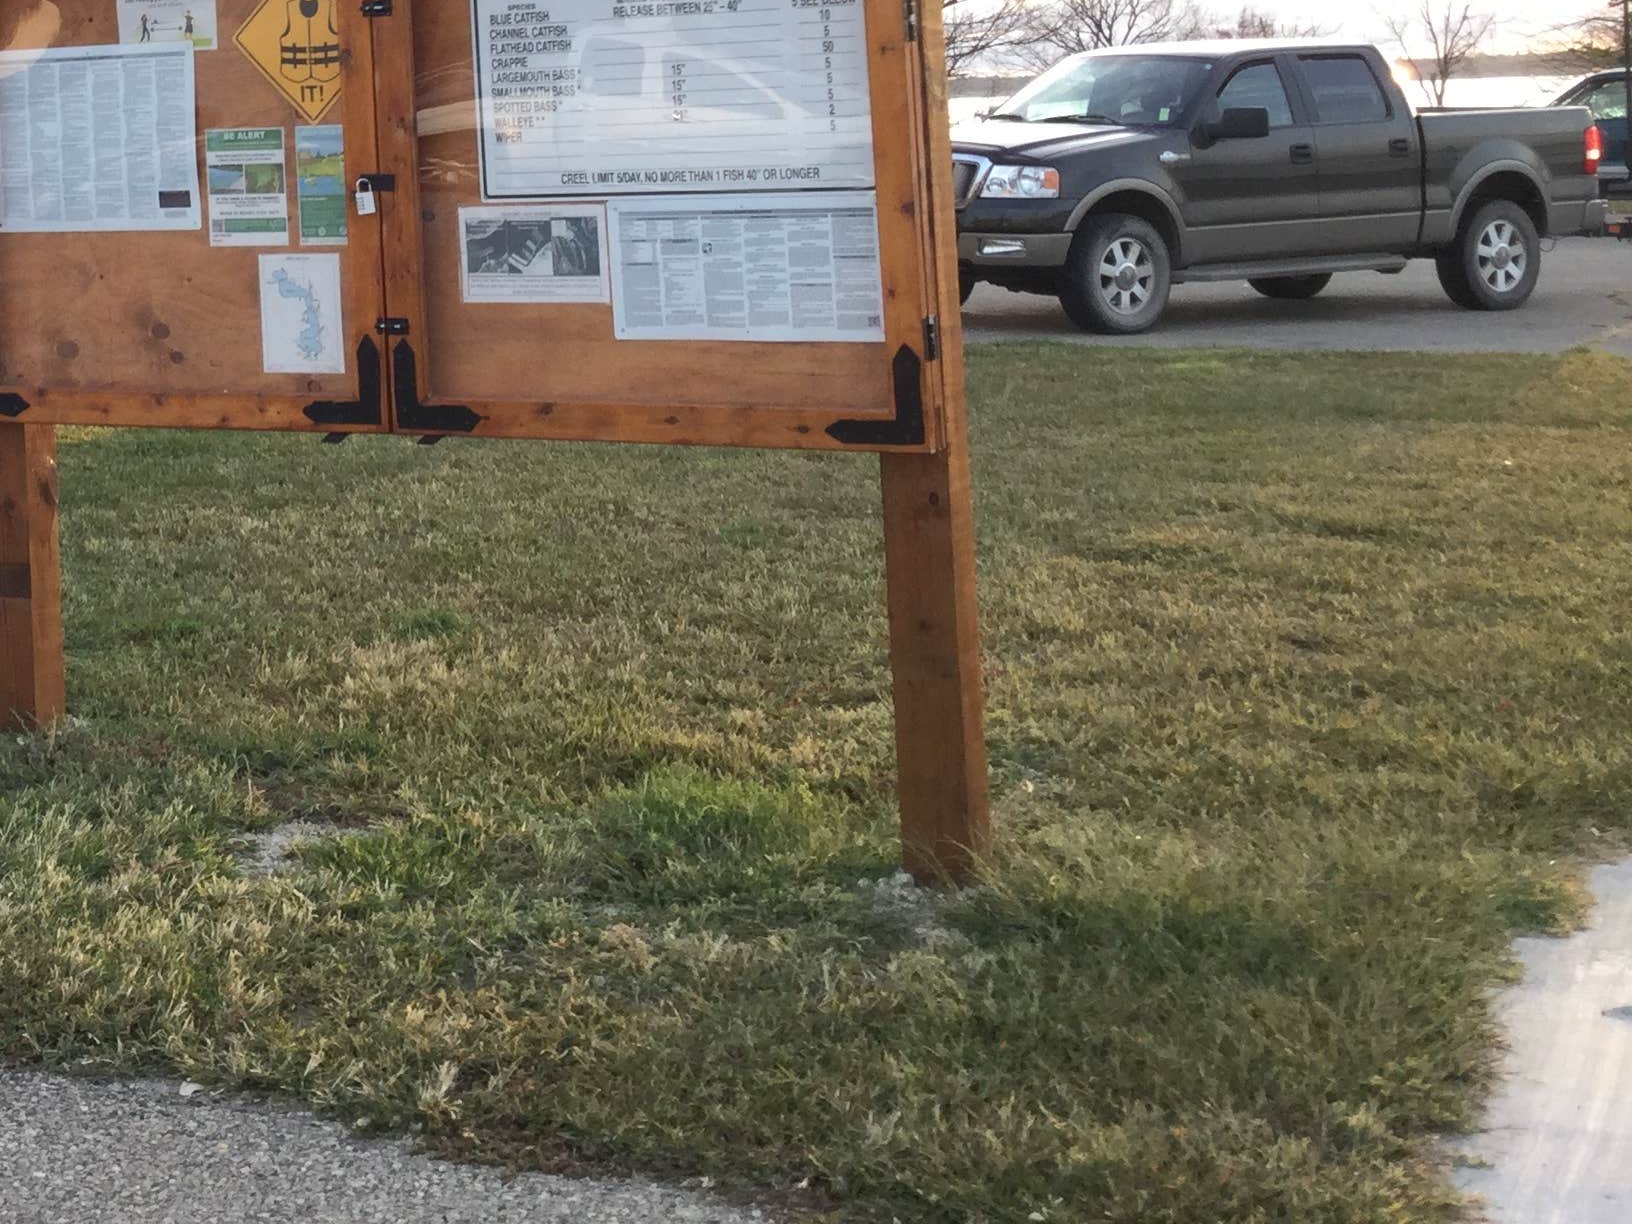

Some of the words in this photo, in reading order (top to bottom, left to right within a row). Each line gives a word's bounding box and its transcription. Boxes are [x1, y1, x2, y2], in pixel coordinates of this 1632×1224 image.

[612, 4, 654, 18] RELEASE
[656, 1, 701, 17] BETWEEN
[489, 13, 512, 26] BLUE
[513, 9, 550, 24] CATFISH
[489, 27, 529, 40] CHANNEL
[531, 24, 568, 38] CATFISH
[823, 24, 831, 38] 5
[489, 41, 534, 55] FLATHEAD
[535, 38, 572, 52] CATFISH
[490, 56, 529, 70] CRAPPIE
[824, 56, 832, 69] 5
[491, 70, 551, 85] LARGEMOUTH
[552, 67, 576, 82] BASS
[299, 84, 325, 103] IT!
[490, 85, 551, 98] SMALLMOUTH
[551, 83, 576, 97] BASS
[827, 87, 834, 100] 5
[493, 101, 533, 114] SPOTTED
[828, 103, 836, 116] 2
[494, 116, 535, 130] WALLEYE
[830, 119, 837, 132] 5
[237, 130, 266, 140] ALERT
[494, 131, 523, 144] WIPER
[560, 172, 589, 185] CREEL
[591, 171, 616, 184] LIMIT
[644, 170, 658, 183] NO
[660, 170, 687, 183] MORE
[687, 169, 714, 182] THAN
[716, 169, 721, 181] 1
[722, 168, 744, 181] FISH
[762, 167, 778, 181] OR
[779, 166, 821, 180] LONGER
